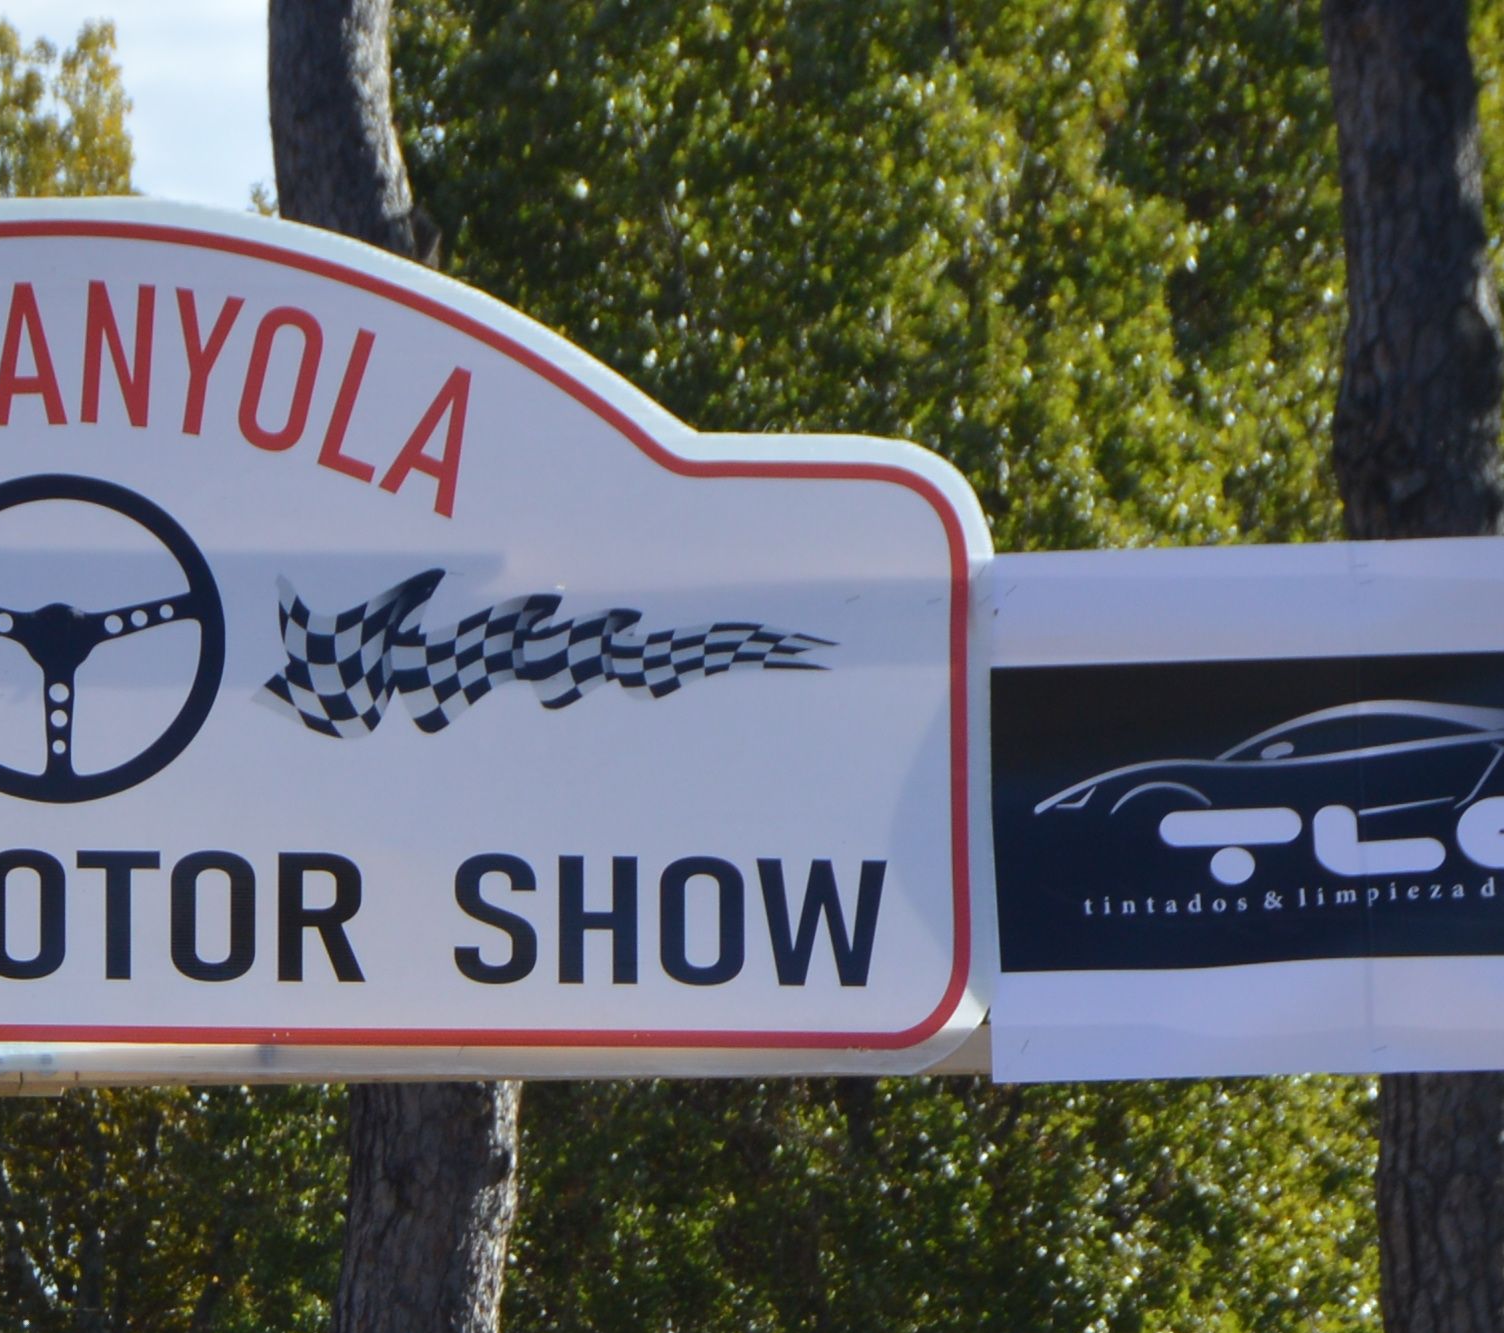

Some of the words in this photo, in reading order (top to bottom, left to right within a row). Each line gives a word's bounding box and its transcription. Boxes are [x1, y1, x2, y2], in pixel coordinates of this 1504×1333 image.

[451, 853, 890, 988] SHOW
[1083, 893, 1248, 915] tintados
[1262, 890, 1283, 910] &
[1298, 878, 1466, 907] limpieza
